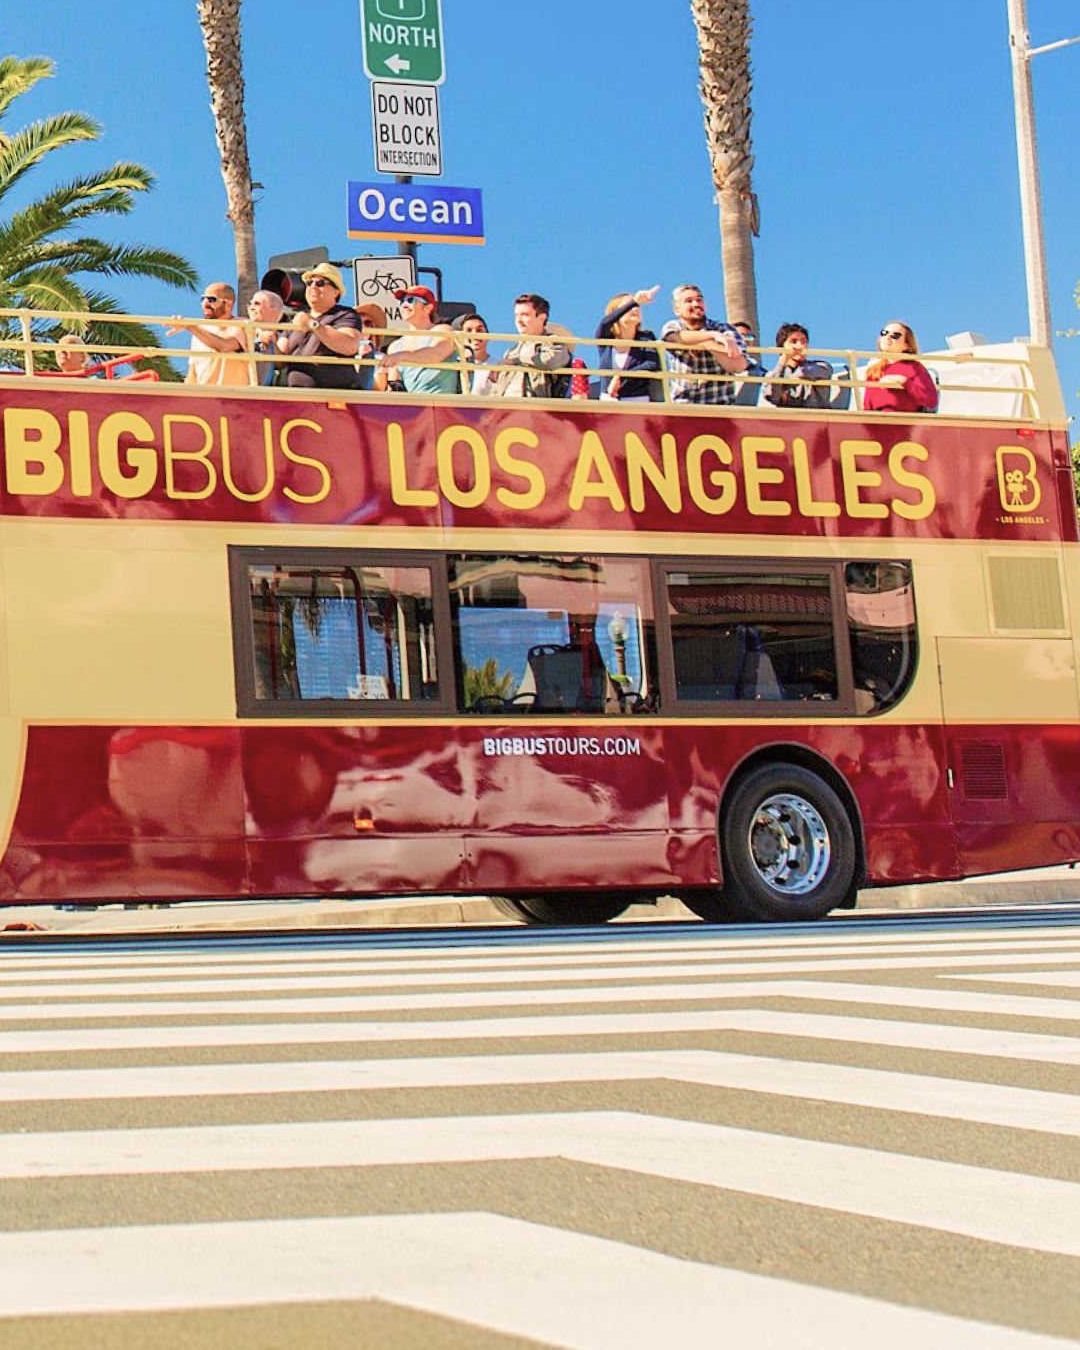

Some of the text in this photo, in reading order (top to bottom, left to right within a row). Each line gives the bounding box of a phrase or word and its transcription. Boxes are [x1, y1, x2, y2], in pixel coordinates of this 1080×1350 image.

[369, 22, 436, 48] NORTH
[378, 93, 433, 117] DO NOT
[379, 123, 435, 146] BLOCK
[379, 150, 437, 166] INTERSECTION
[358, 188, 473, 225] Ocean
[4, 408, 936, 520] BIGBUS LOS ANGELES
[1001, 516, 1045, 524] LOS ANGELES
[483, 737, 641, 756] BIGBUSTOURS.COM
